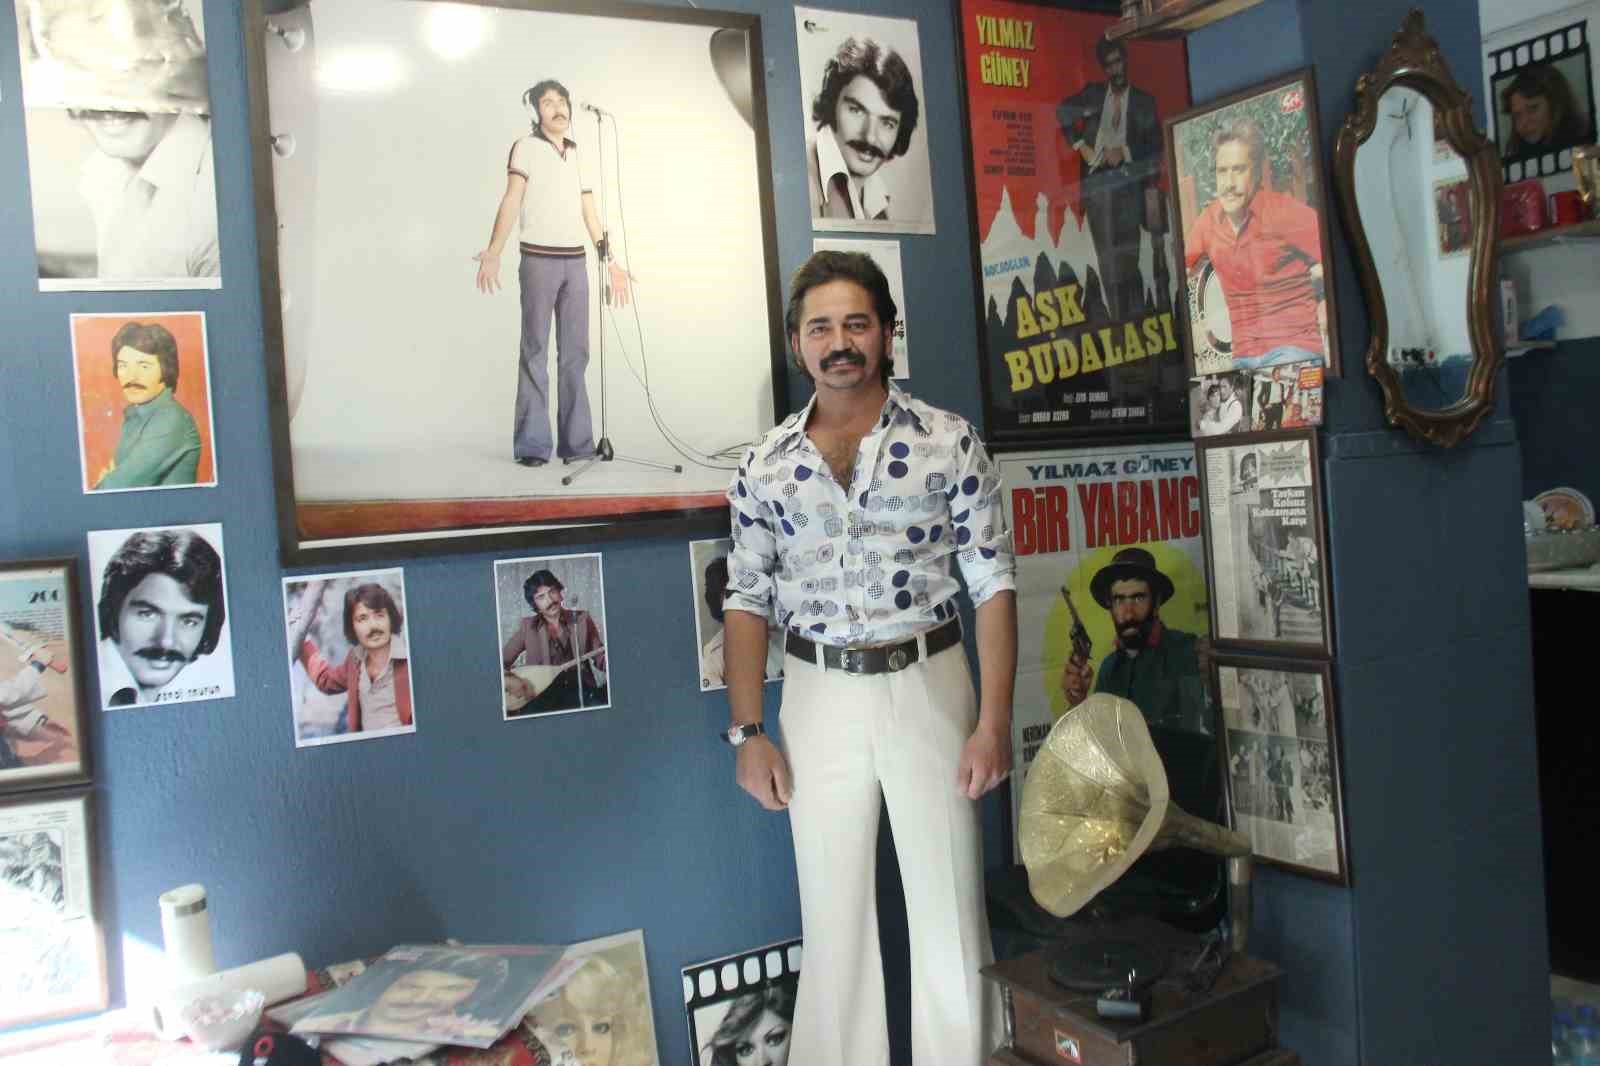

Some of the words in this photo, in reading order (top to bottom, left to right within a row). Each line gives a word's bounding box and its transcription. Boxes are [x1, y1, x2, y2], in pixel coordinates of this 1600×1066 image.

[976, 15, 1034, 50] YILMAZ
[980, 51, 1029, 88] GÜNEY
[1016, 283, 1086, 340] AŞK
[1004, 312, 1177, 393] BUDALASI
[1026, 461, 1117, 481] YILMAZ
[1123, 455, 1194, 474] GÜNEY
